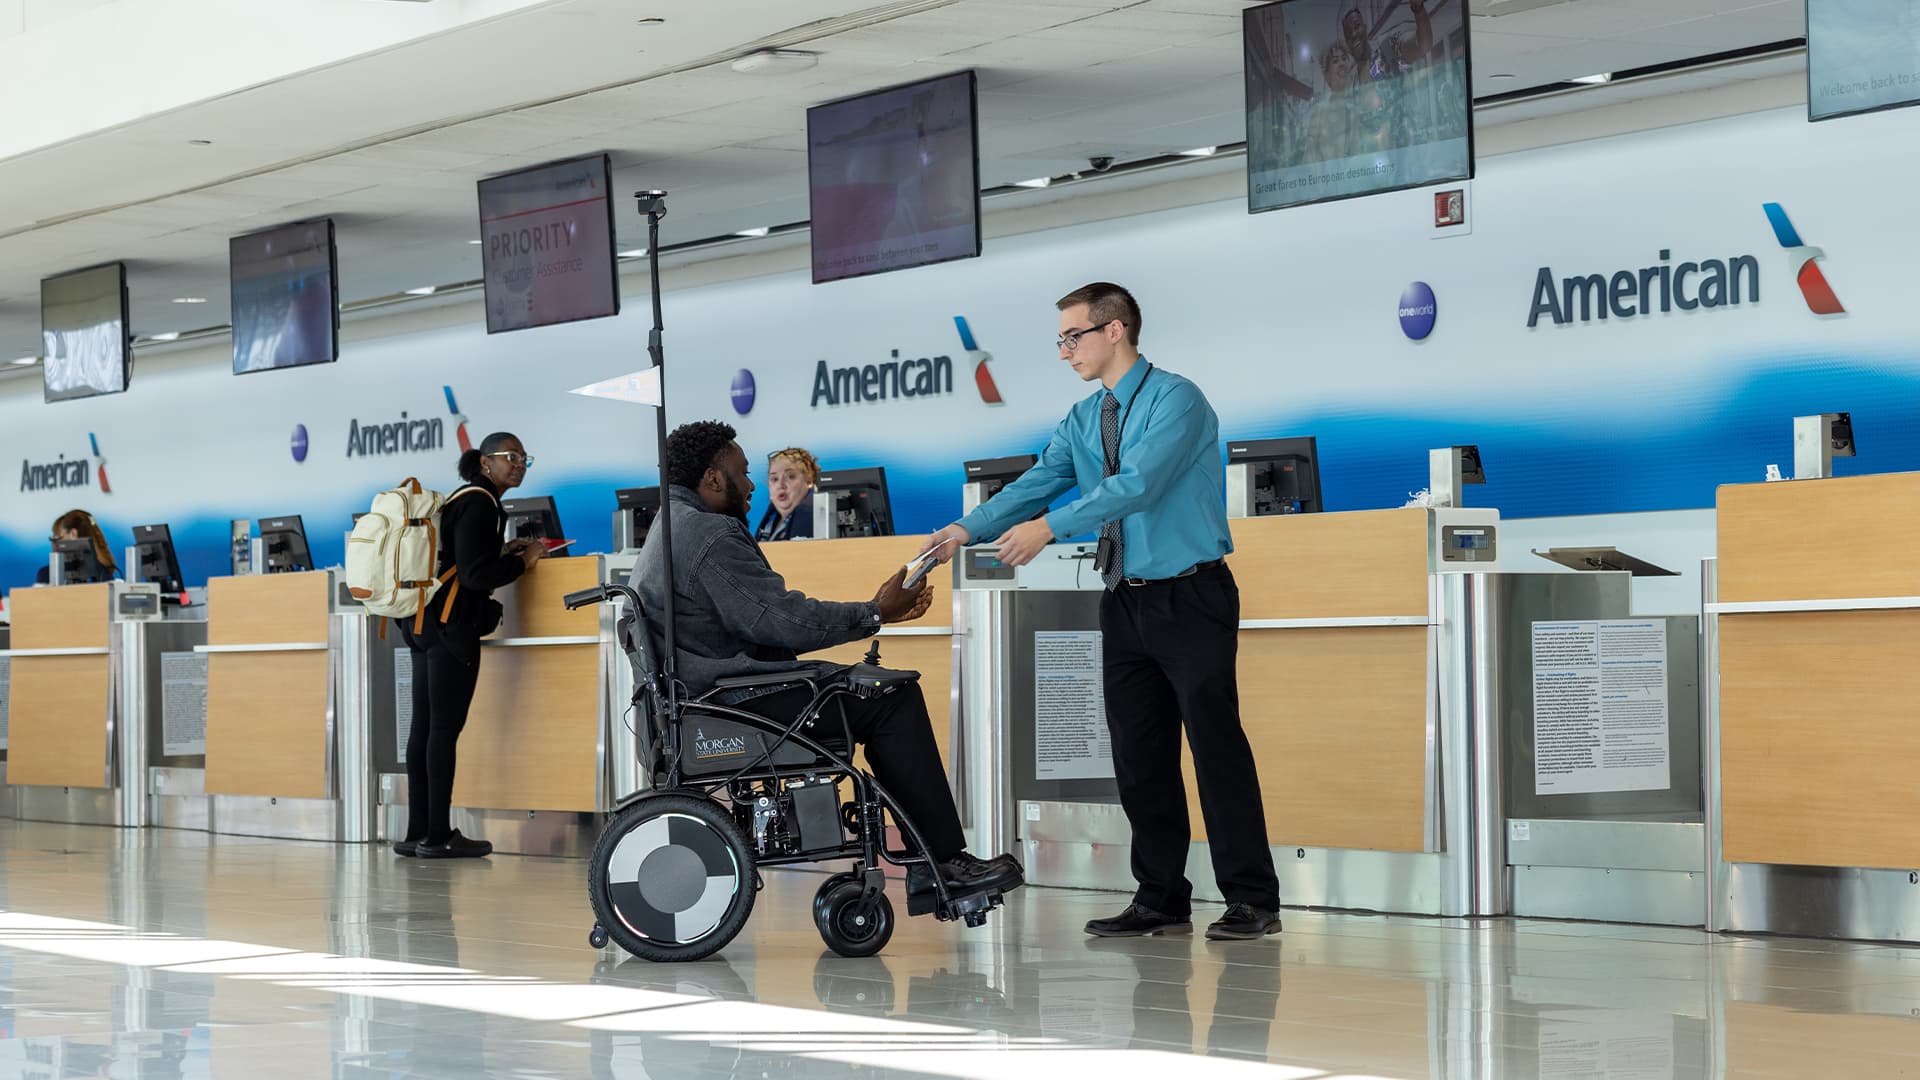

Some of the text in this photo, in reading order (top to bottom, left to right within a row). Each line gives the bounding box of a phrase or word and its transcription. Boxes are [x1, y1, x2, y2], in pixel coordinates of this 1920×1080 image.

[1818, 80, 1868, 96] Welcome
[1871, 73, 1895, 89] back
[1898, 73, 1909, 84] to
[1255, 182, 1276, 194] Great
[1278, 179, 1297, 191] fares
[1298, 178, 1307, 187] to
[1308, 170, 1345, 186] European
[490, 220, 574, 260] PRIORITY
[1527, 248, 1760, 328] American
[1399, 303, 1433, 317] oneworld
[810, 349, 952, 407] American
[347, 412, 443, 459] American
[20, 453, 89, 494] American
[696, 737, 744, 751] MORGAN
